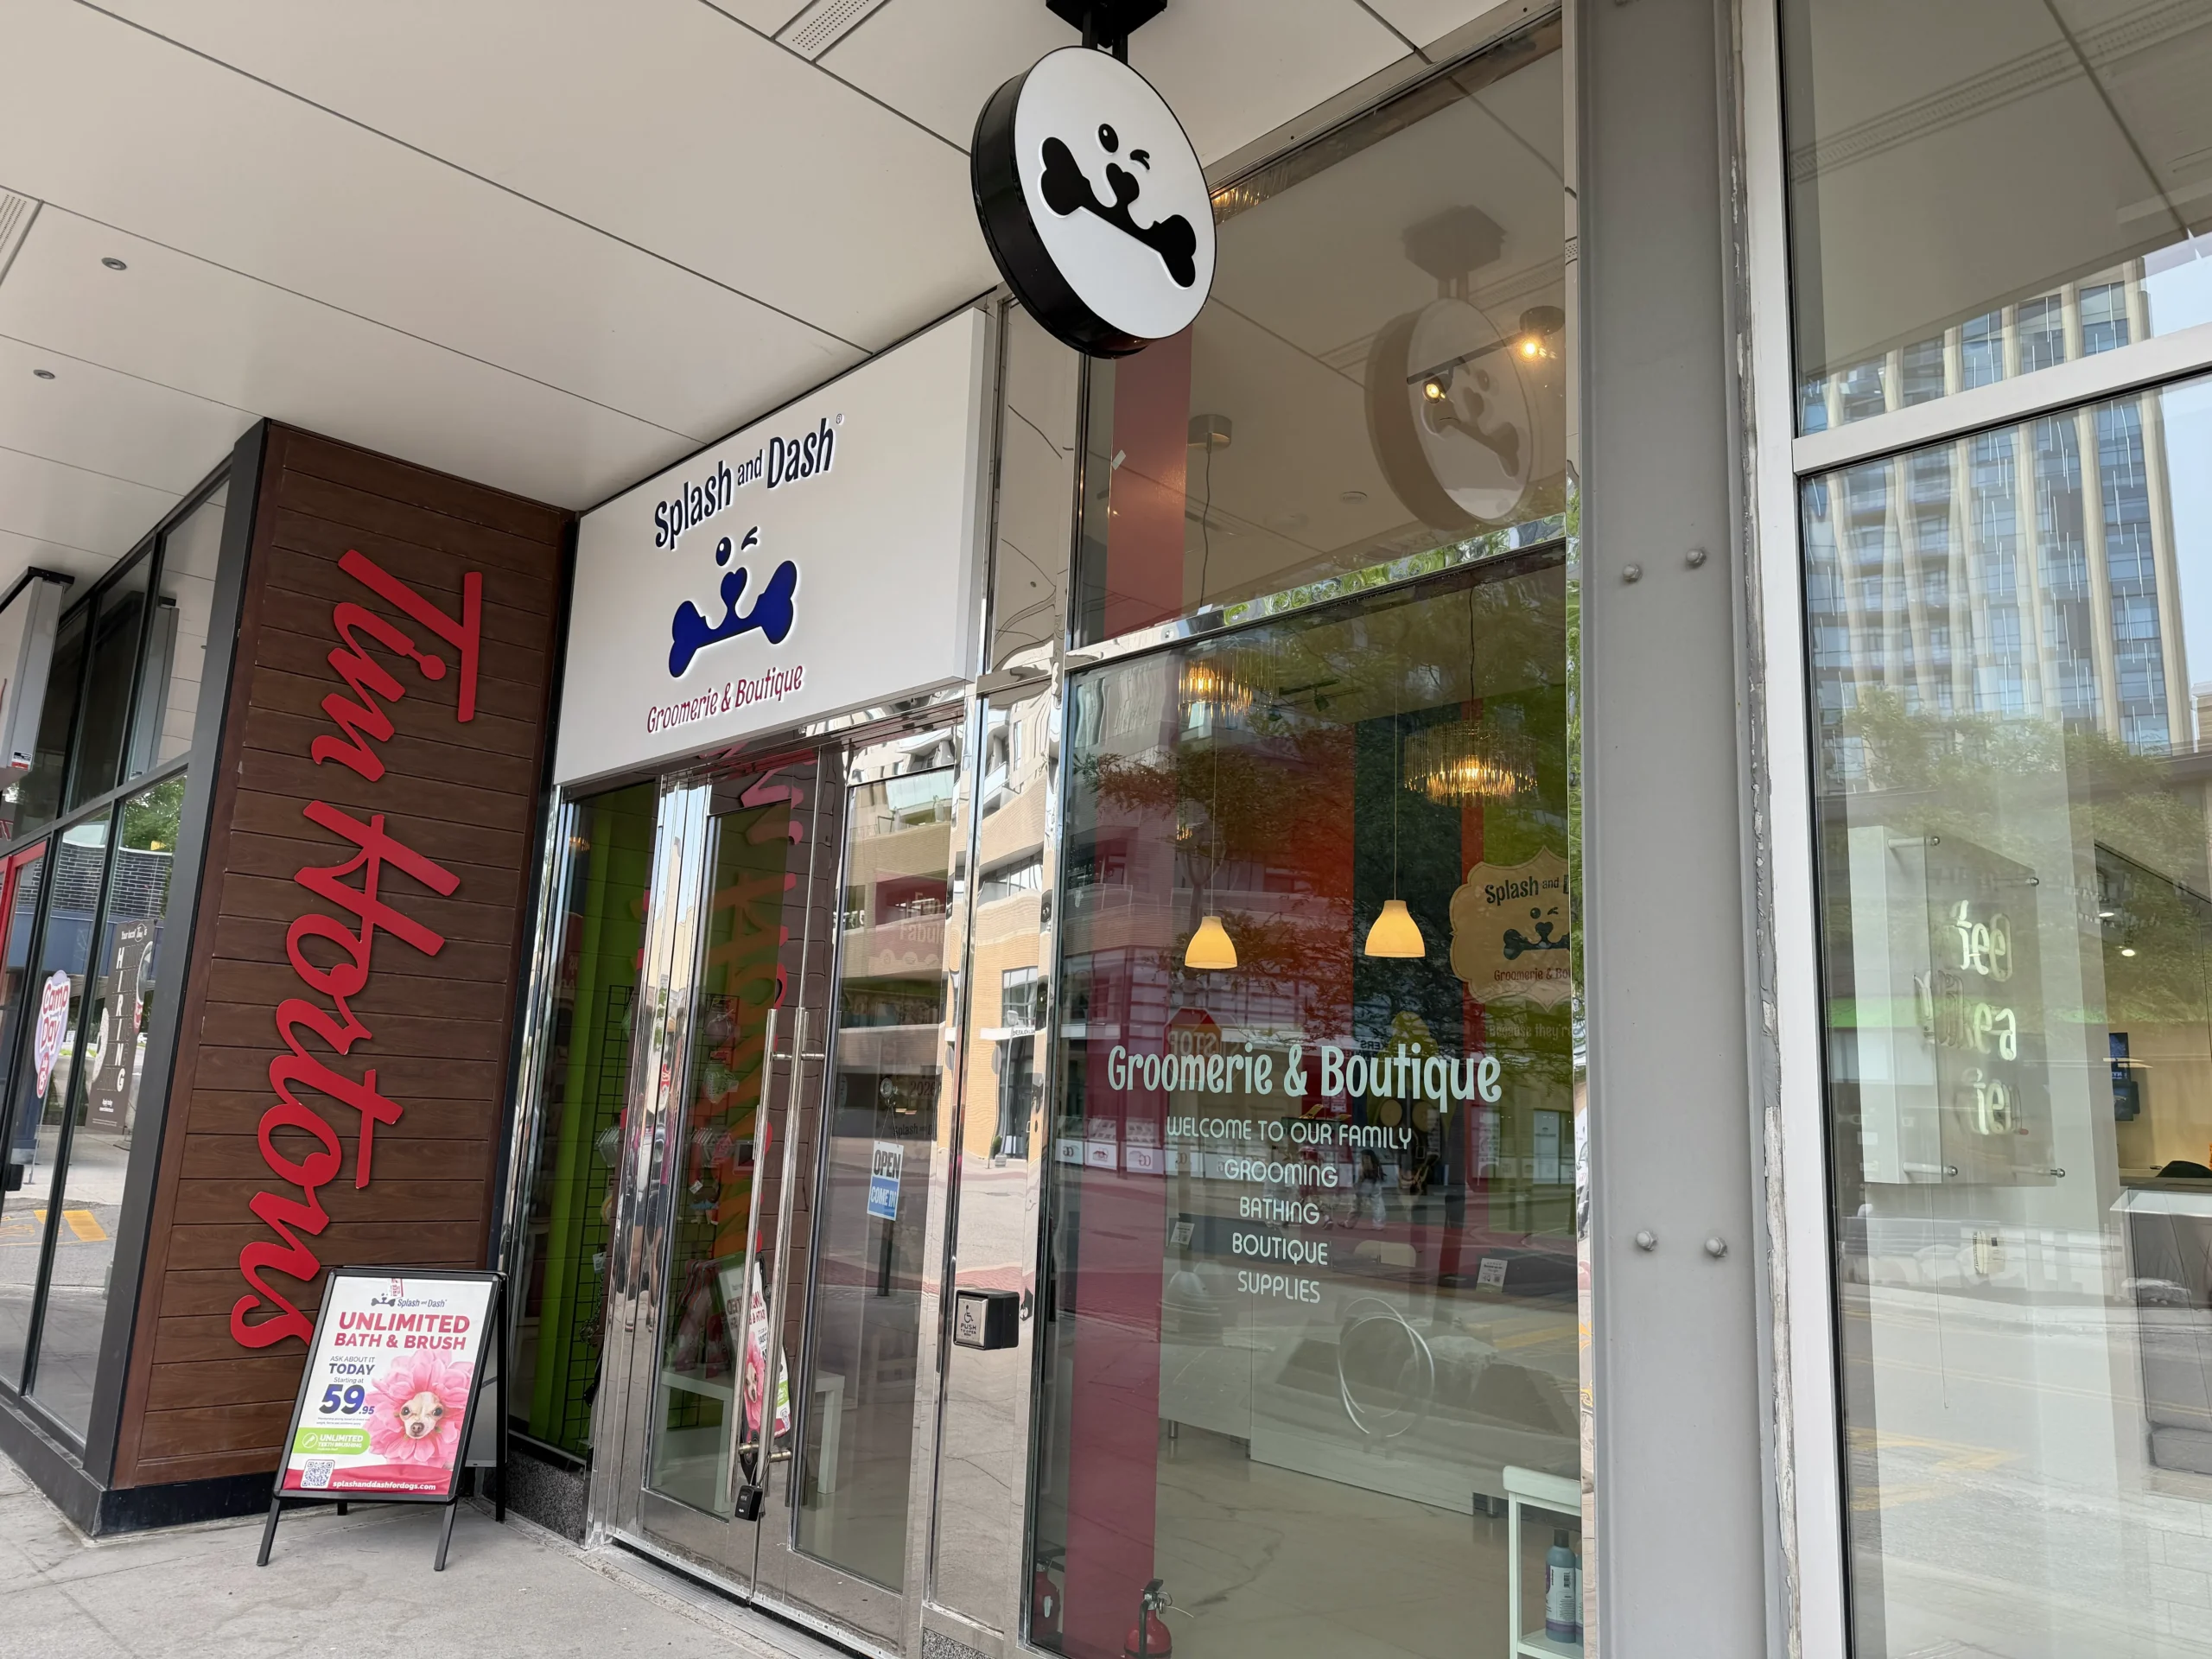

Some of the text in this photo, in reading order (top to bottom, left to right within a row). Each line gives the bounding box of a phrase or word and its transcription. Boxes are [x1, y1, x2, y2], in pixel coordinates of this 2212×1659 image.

[654, 417, 835, 550] Splash and Dash
[646, 665, 804, 734] Groomerie & Boutique
[1484, 875, 1539, 906] Splash
[1542, 876, 1560, 890] and
[231, 550, 482, 1348] Tim Hortons
[1493, 968, 1543, 982] Groomerie
[1545, 969, 1553, 980] &
[42, 983, 69, 1016] Camp
[41, 1016, 60, 1052] Day
[1489, 1024, 1532, 1039] Because
[1108, 1042, 1502, 1113] Groomerie & Boutique
[1166, 1116, 1252, 1141] WELCOME
[1258, 1120, 1285, 1141] TO
[1290, 1122, 1332, 1145] OUR
[1338, 1124, 1413, 1150] FAMILY
[874, 1149, 901, 1179] OPEN
[1224, 1159, 1338, 1188] GROOMING
[870, 1185, 897, 1208] COME IN
[1239, 1196, 1320, 1224] BATHING
[1232, 1232, 1328, 1266] BOUTIQUE
[1237, 1270, 1320, 1303] SUPPLIES
[397, 1299, 420, 1308] Splash
[427, 1299, 445, 1307] Dash
[339, 1312, 470, 1333] UNLIMITED
[334, 1332, 467, 1350] BATH & BRUSH
[328, 1363, 376, 1375] TODAY
[333, 1481, 436, 1491] splashanddashfordogs.com
